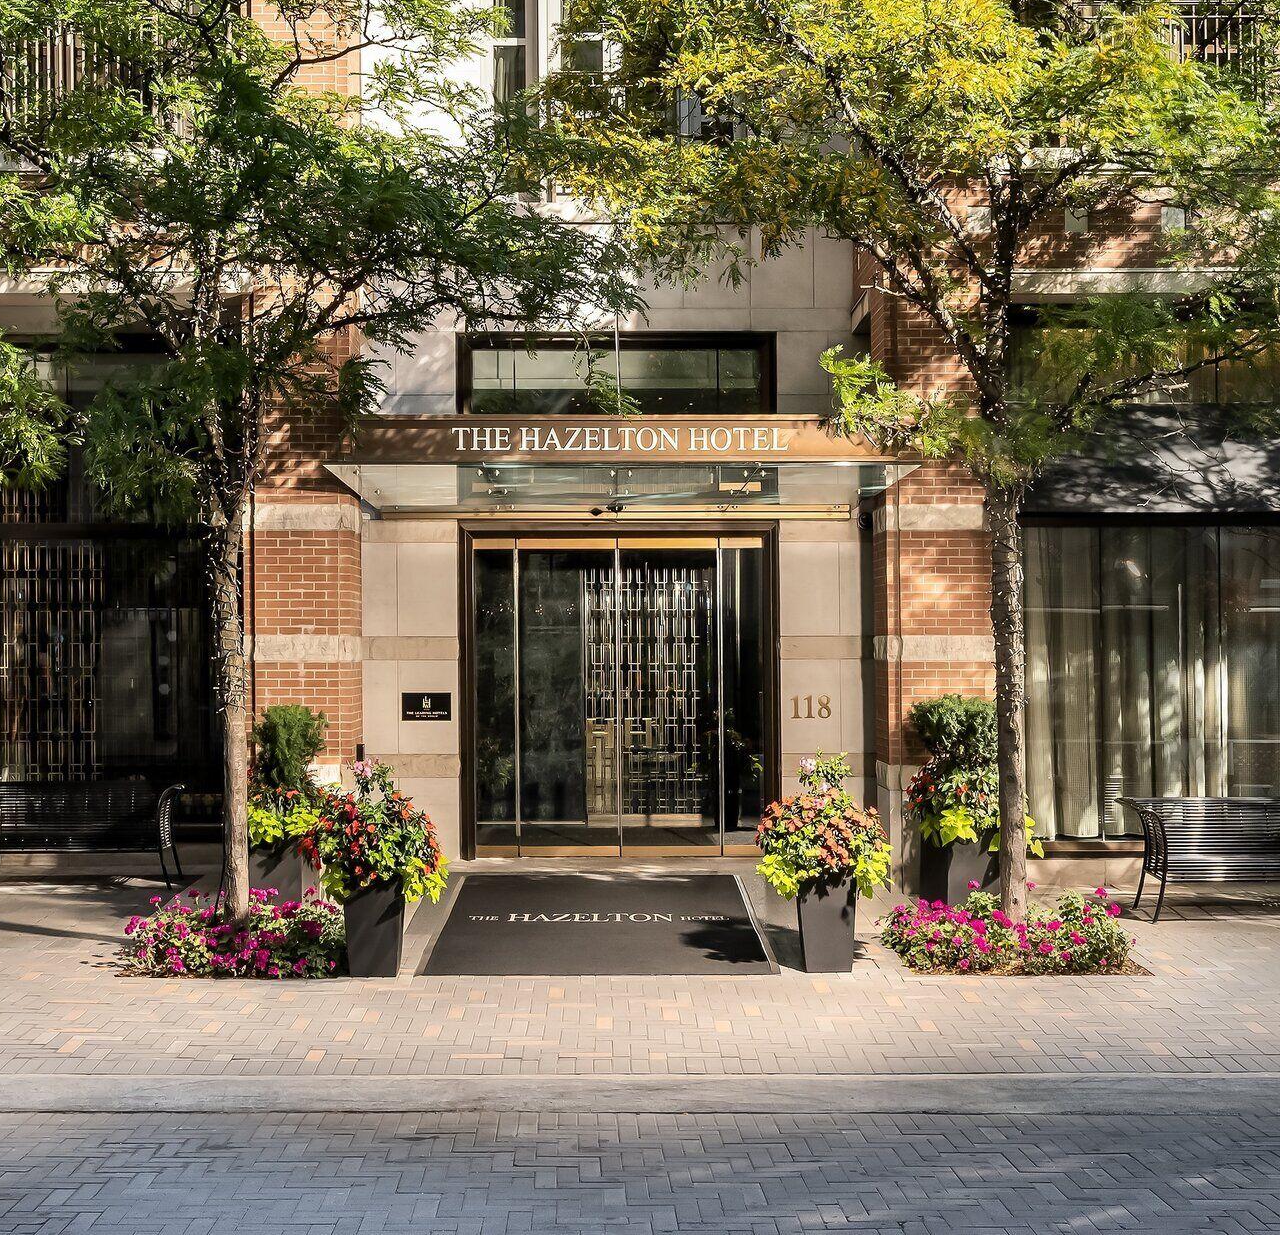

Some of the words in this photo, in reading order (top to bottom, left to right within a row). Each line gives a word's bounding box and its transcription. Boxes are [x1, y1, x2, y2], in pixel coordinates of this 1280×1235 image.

[450, 427, 511, 451] THE
[518, 427, 680, 451] HAZELTON
[687, 427, 790, 451] HOTEL
[790, 695, 831, 719] 118
[507, 913, 672, 922] HAZELTON
